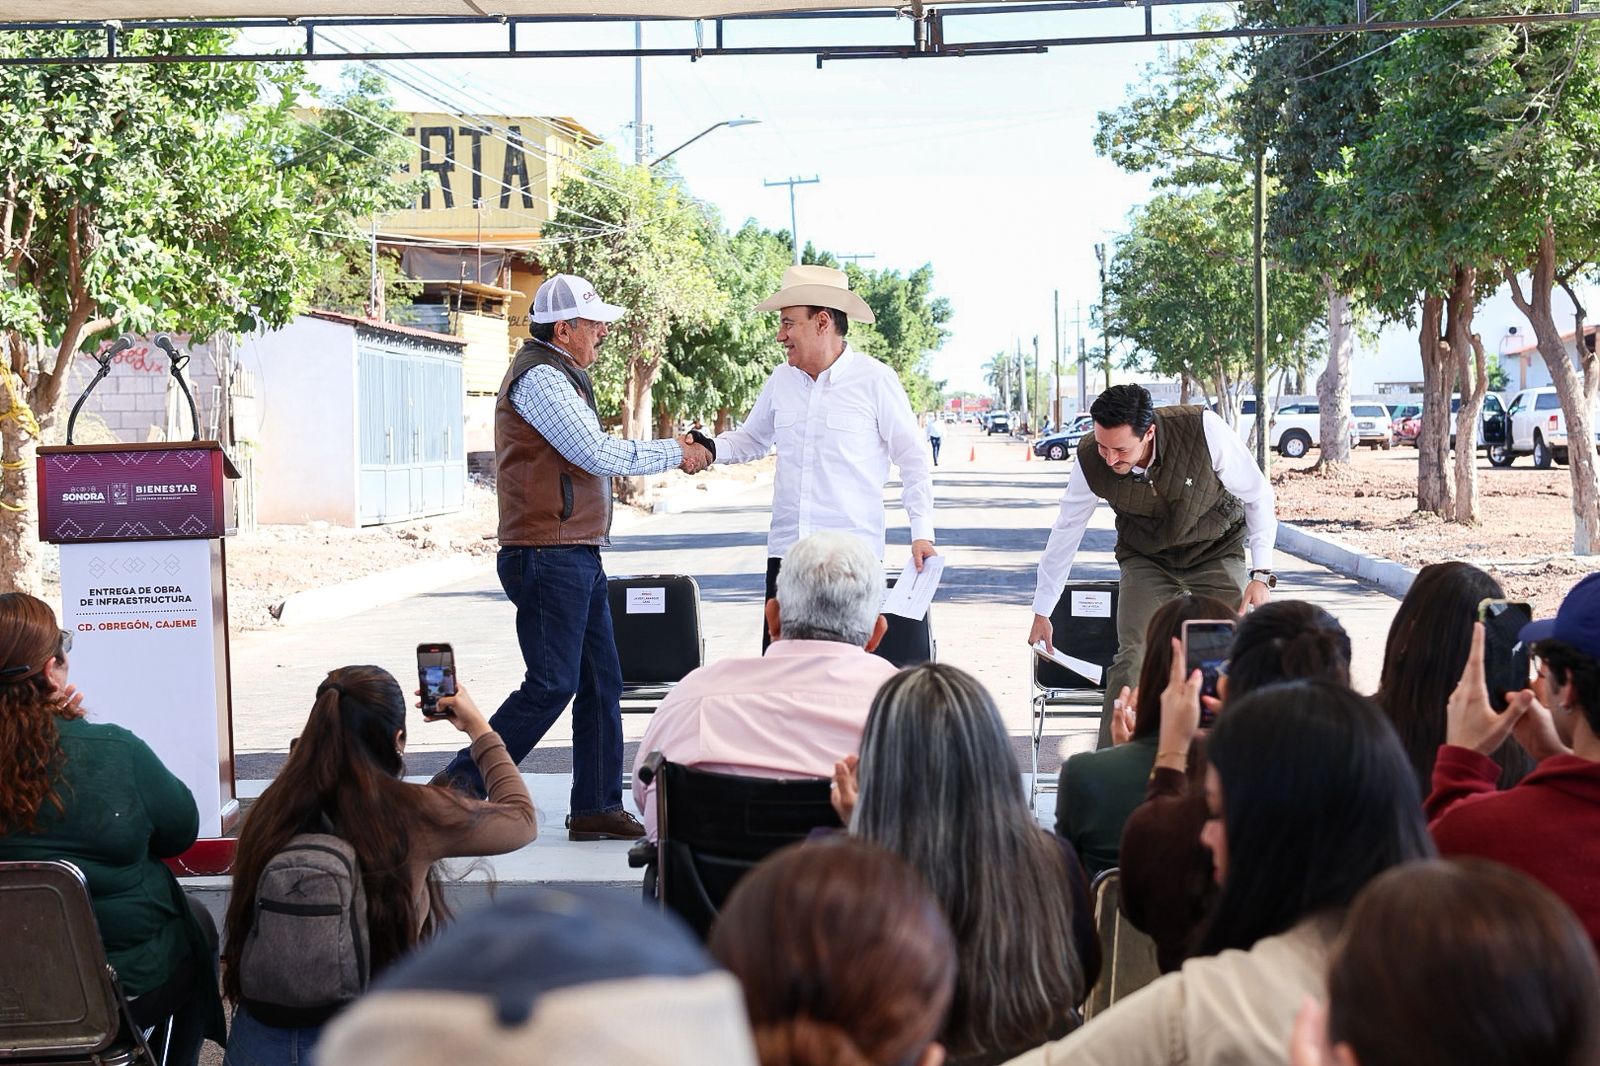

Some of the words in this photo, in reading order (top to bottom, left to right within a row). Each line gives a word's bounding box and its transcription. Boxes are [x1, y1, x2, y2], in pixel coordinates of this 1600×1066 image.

[135, 484, 197, 493] BIENESTAR
[62, 492, 105, 501] SONORA
[89, 587, 136, 596] ENTREGA
[138, 586, 152, 594] DE
[154, 585, 182, 593] OBRA
[96, 595, 192, 605] INFRAESTRUCTURA
[78, 623, 96, 631] CD.
[98, 620, 153, 630] OBREGÓN,
[155, 619, 197, 628] CAJEME
